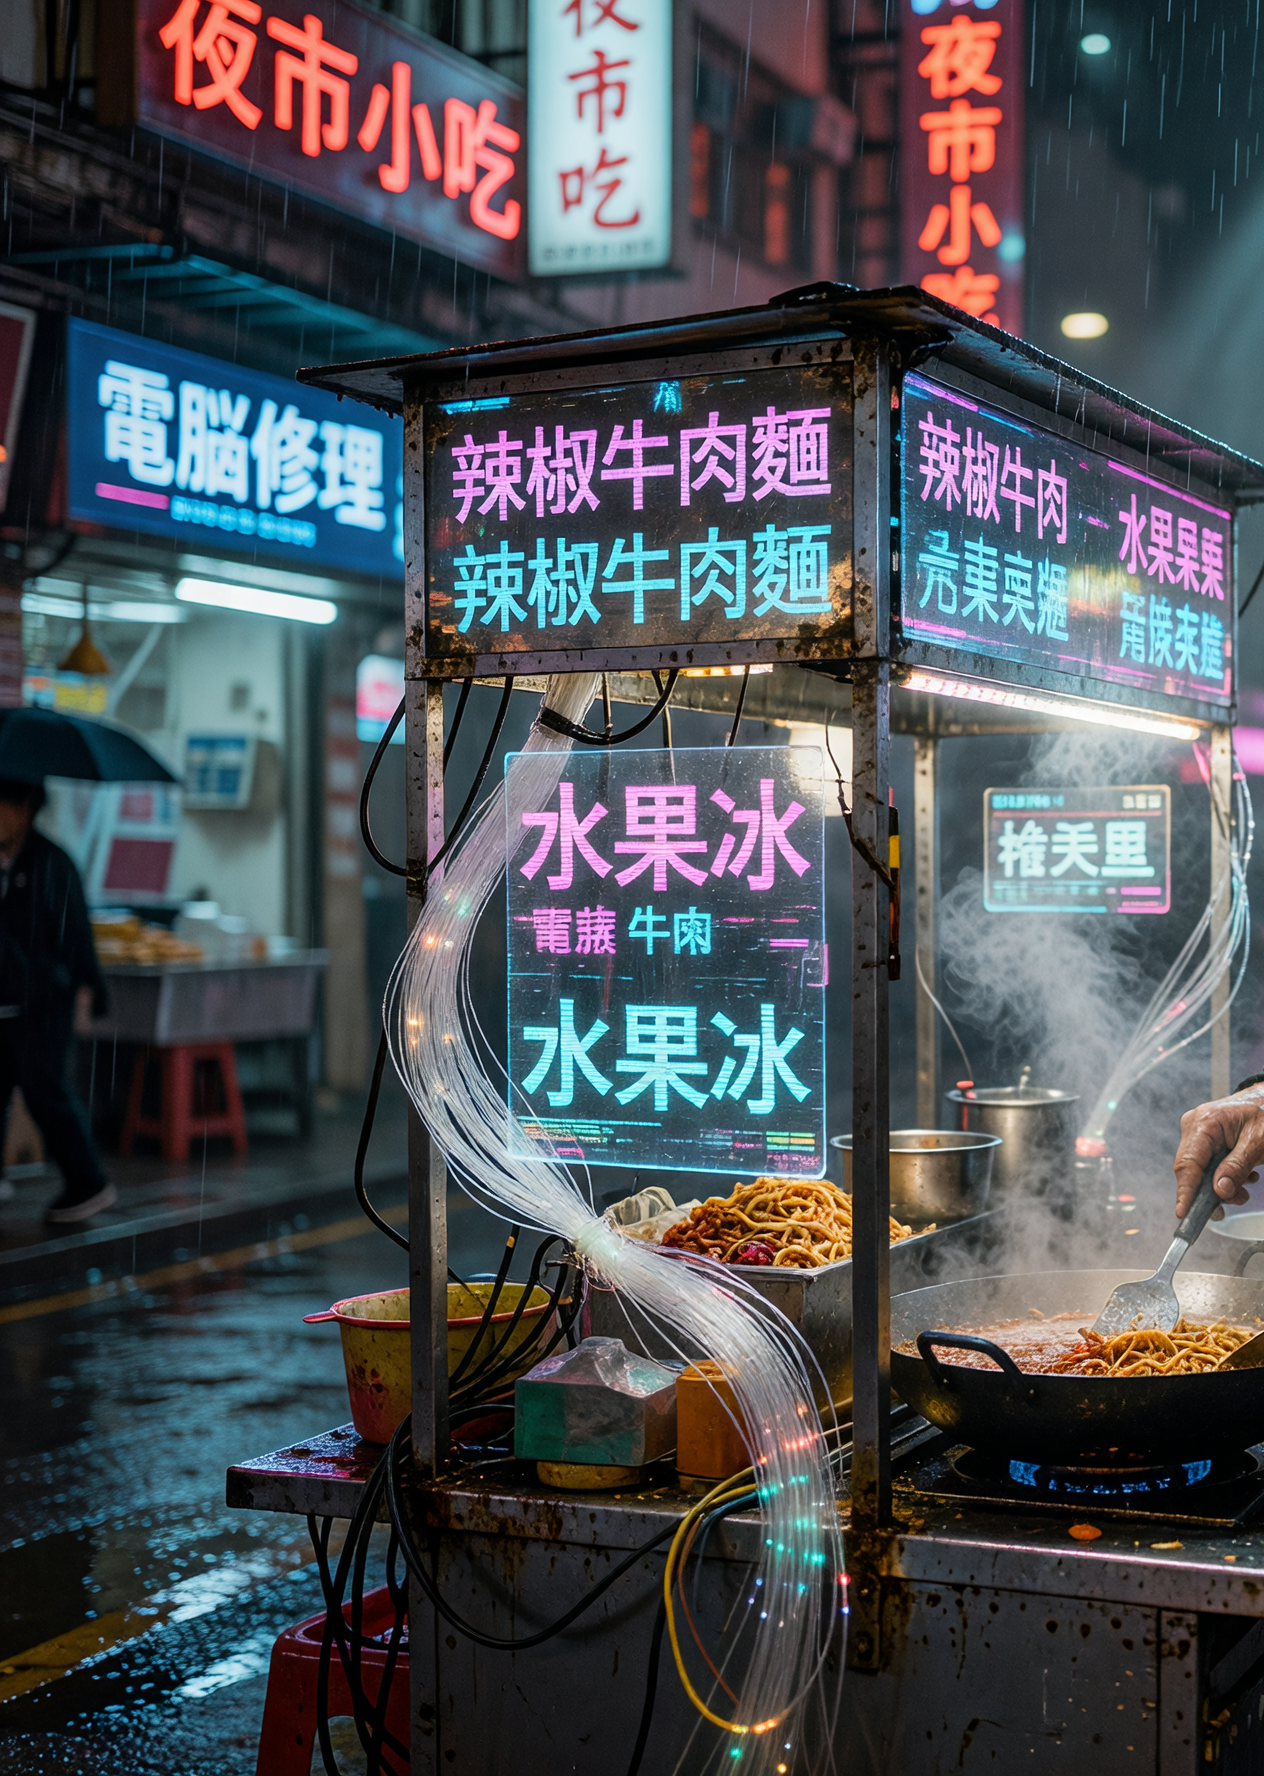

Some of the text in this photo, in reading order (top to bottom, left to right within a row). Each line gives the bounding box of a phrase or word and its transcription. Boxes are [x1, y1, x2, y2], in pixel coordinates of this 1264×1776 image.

[97, 359, 387, 533] 電腦修理
[451, 406, 832, 524] 辣椒牛肉麵
[918, 411, 1068, 544] 辣椒牛肉
[453, 524, 832, 634] 辣椒牛肉麵
[519, 778, 812, 892] 水果冰
[520, 998, 812, 1115] 水果冰
